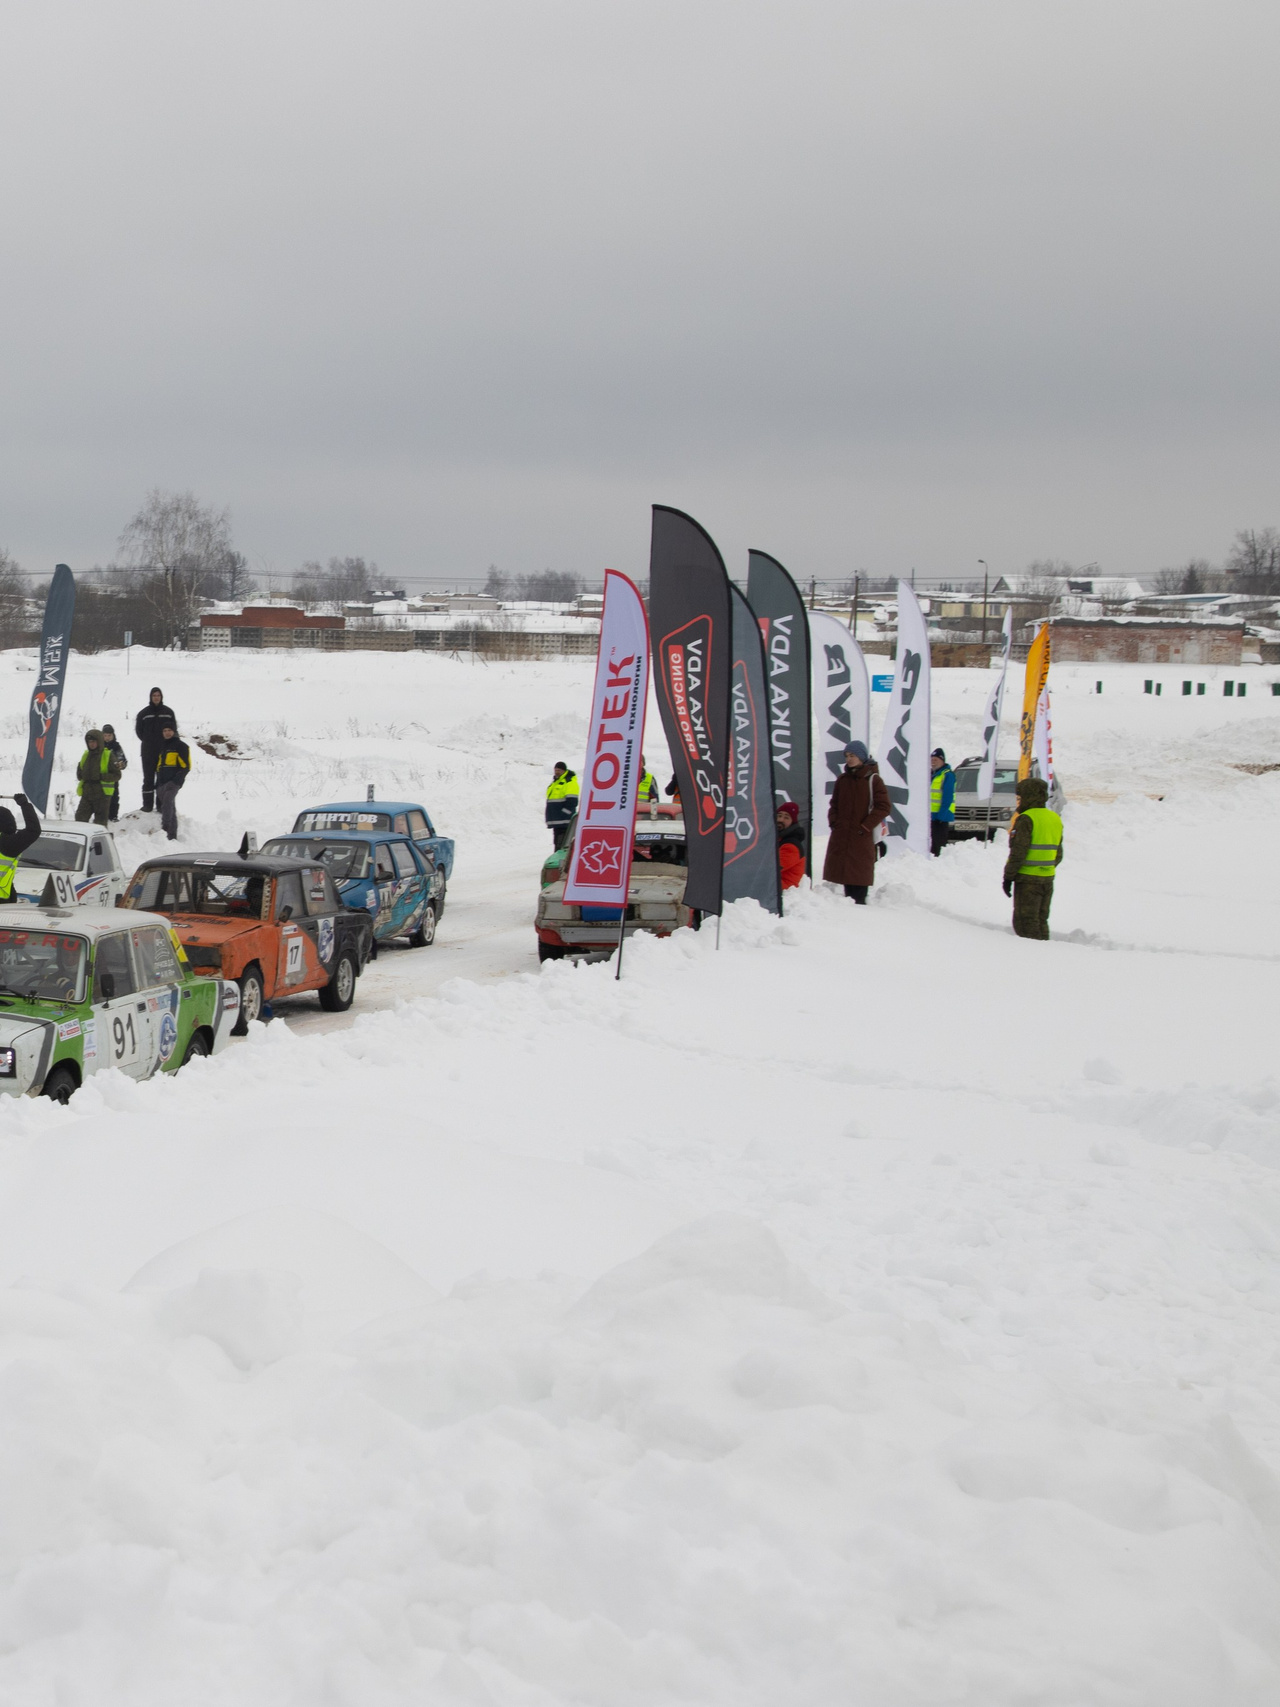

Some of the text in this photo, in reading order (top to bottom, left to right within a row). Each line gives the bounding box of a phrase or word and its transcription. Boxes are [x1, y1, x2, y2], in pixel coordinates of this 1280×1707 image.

[619, 655, 642, 810] ТОПЛИВНЫЕ ТЕХНОЛОГИИ
[304, 813, 378, 824] ДМИТОВ
[56, 874, 77, 903] 91
[290, 946, 300, 964] 17
[113, 1013, 136, 1060] 91
